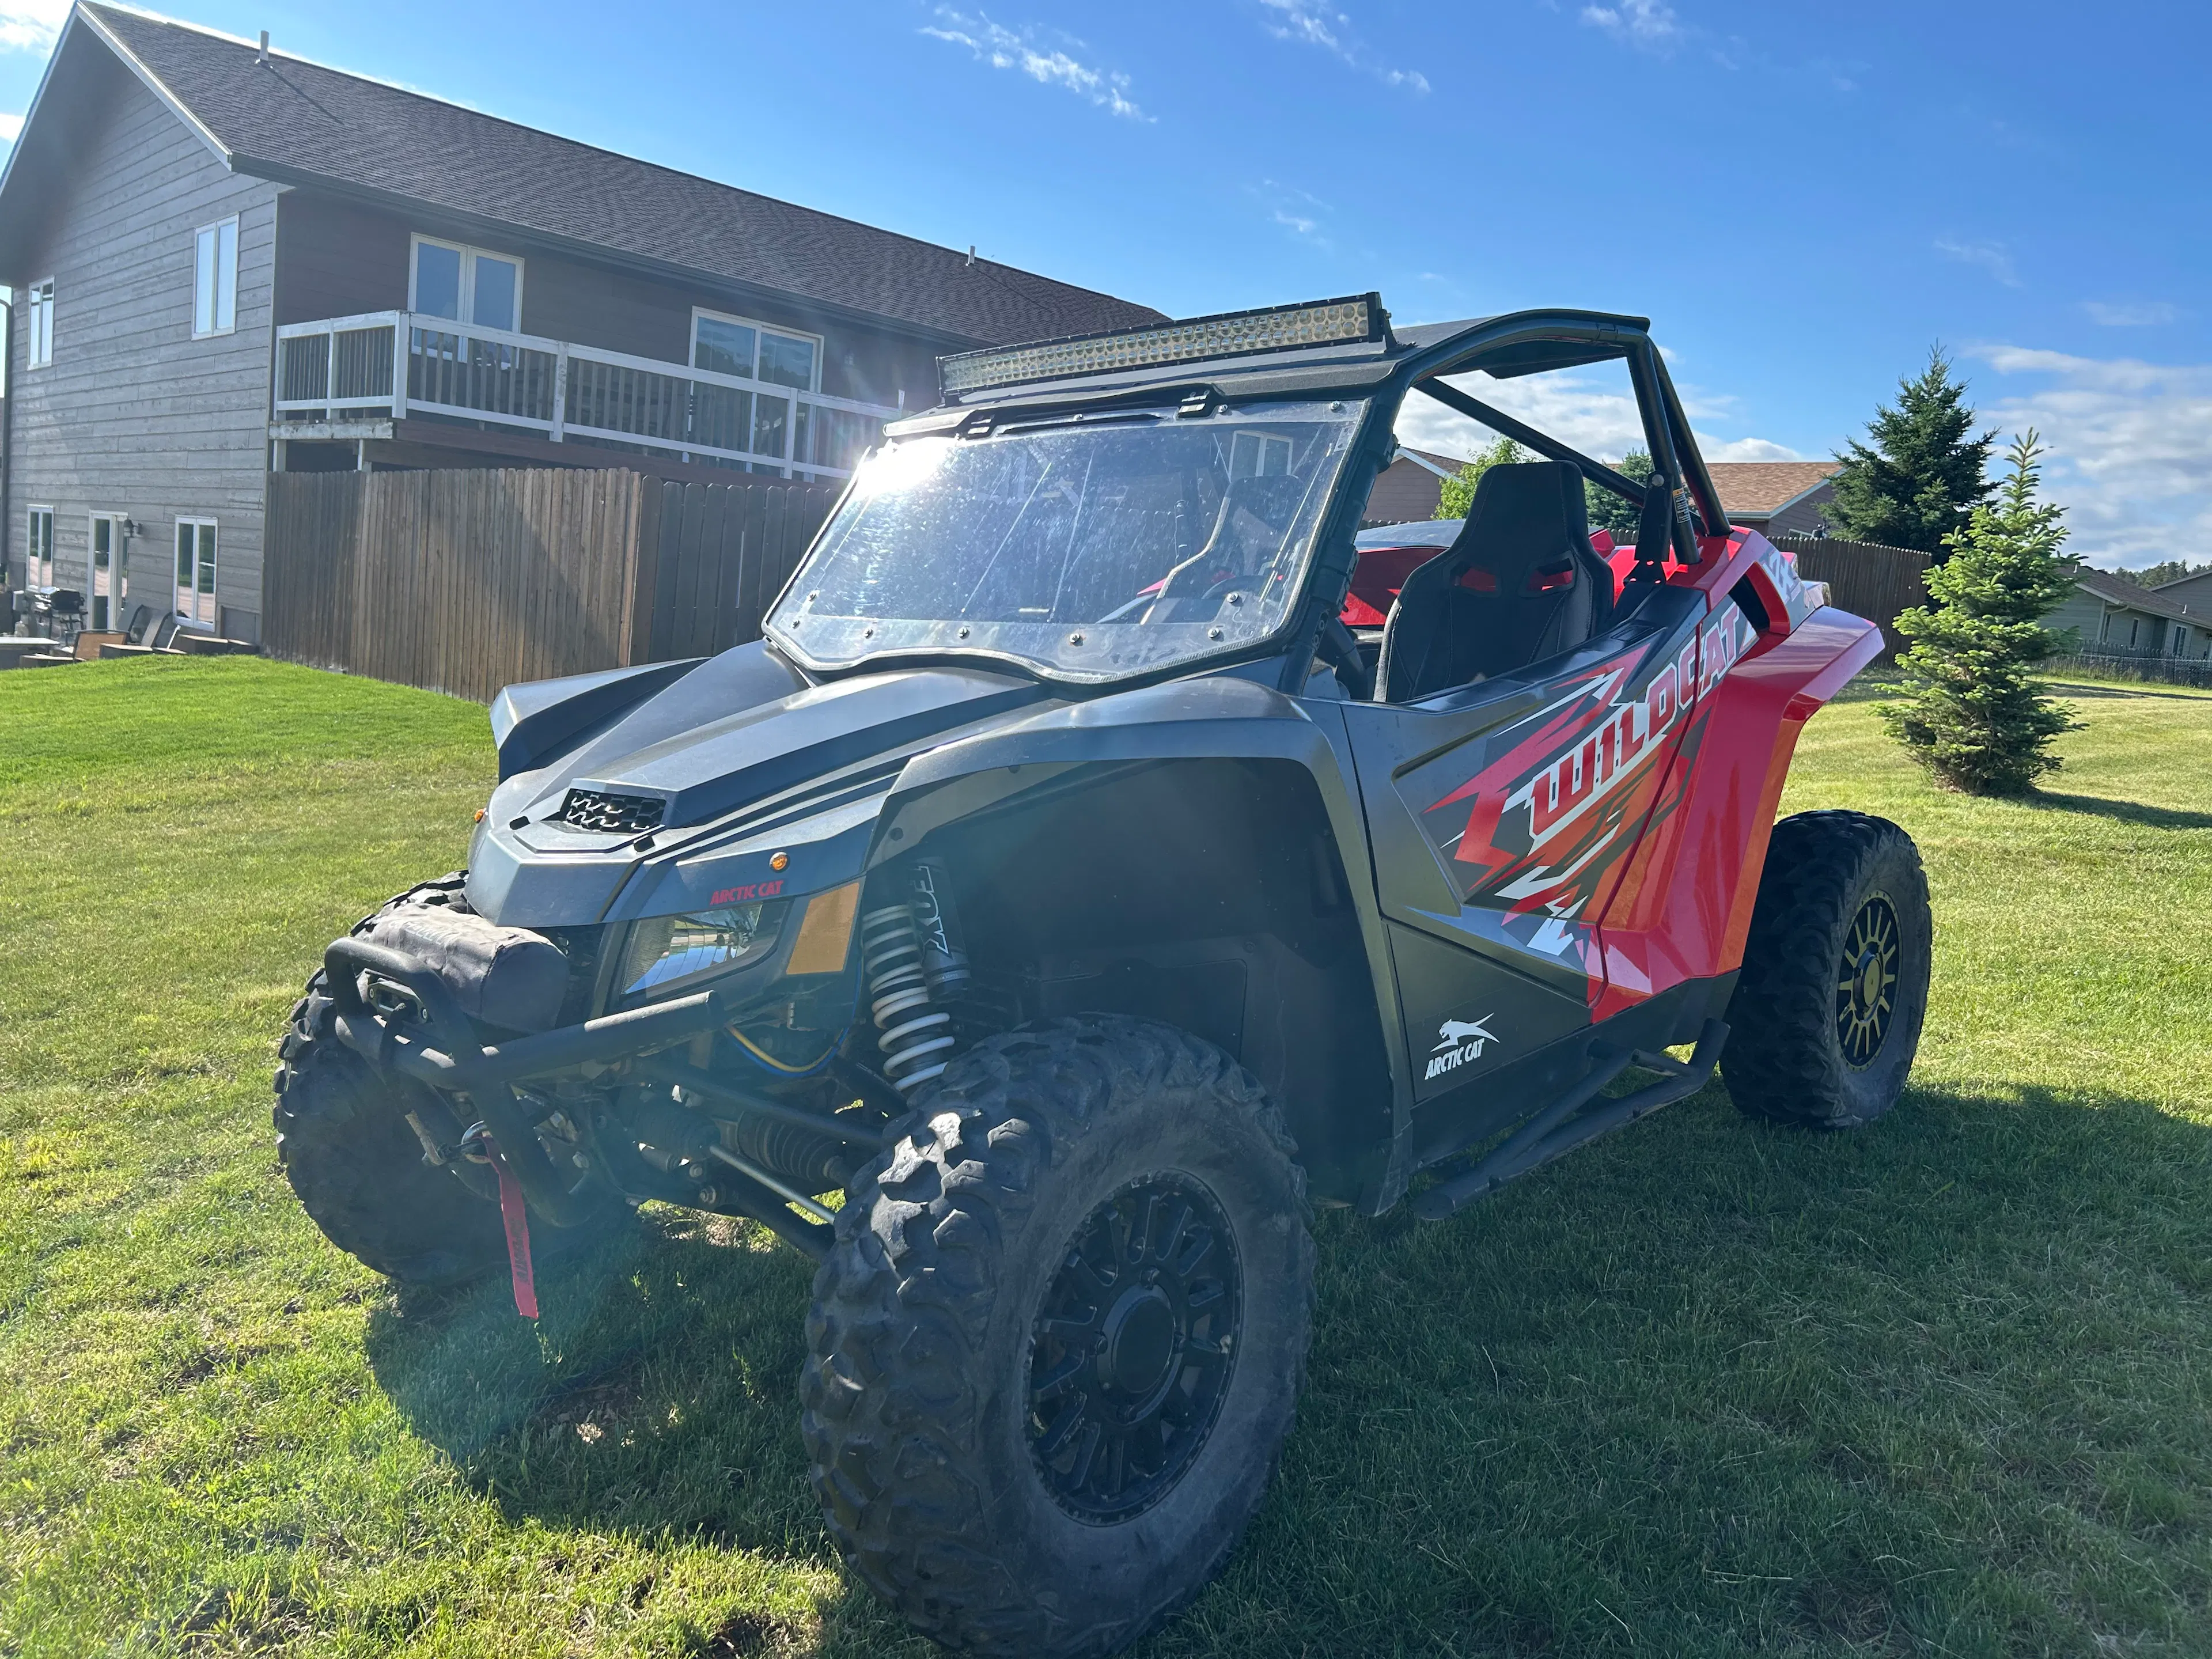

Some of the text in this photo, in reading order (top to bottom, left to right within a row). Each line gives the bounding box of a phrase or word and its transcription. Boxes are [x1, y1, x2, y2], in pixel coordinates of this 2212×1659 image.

[1527, 601, 1741, 843] WILDCAT
[710, 880, 784, 906] ARCTIC CAT
[1424, 1037, 1484, 1080] ARCTIC CAT
